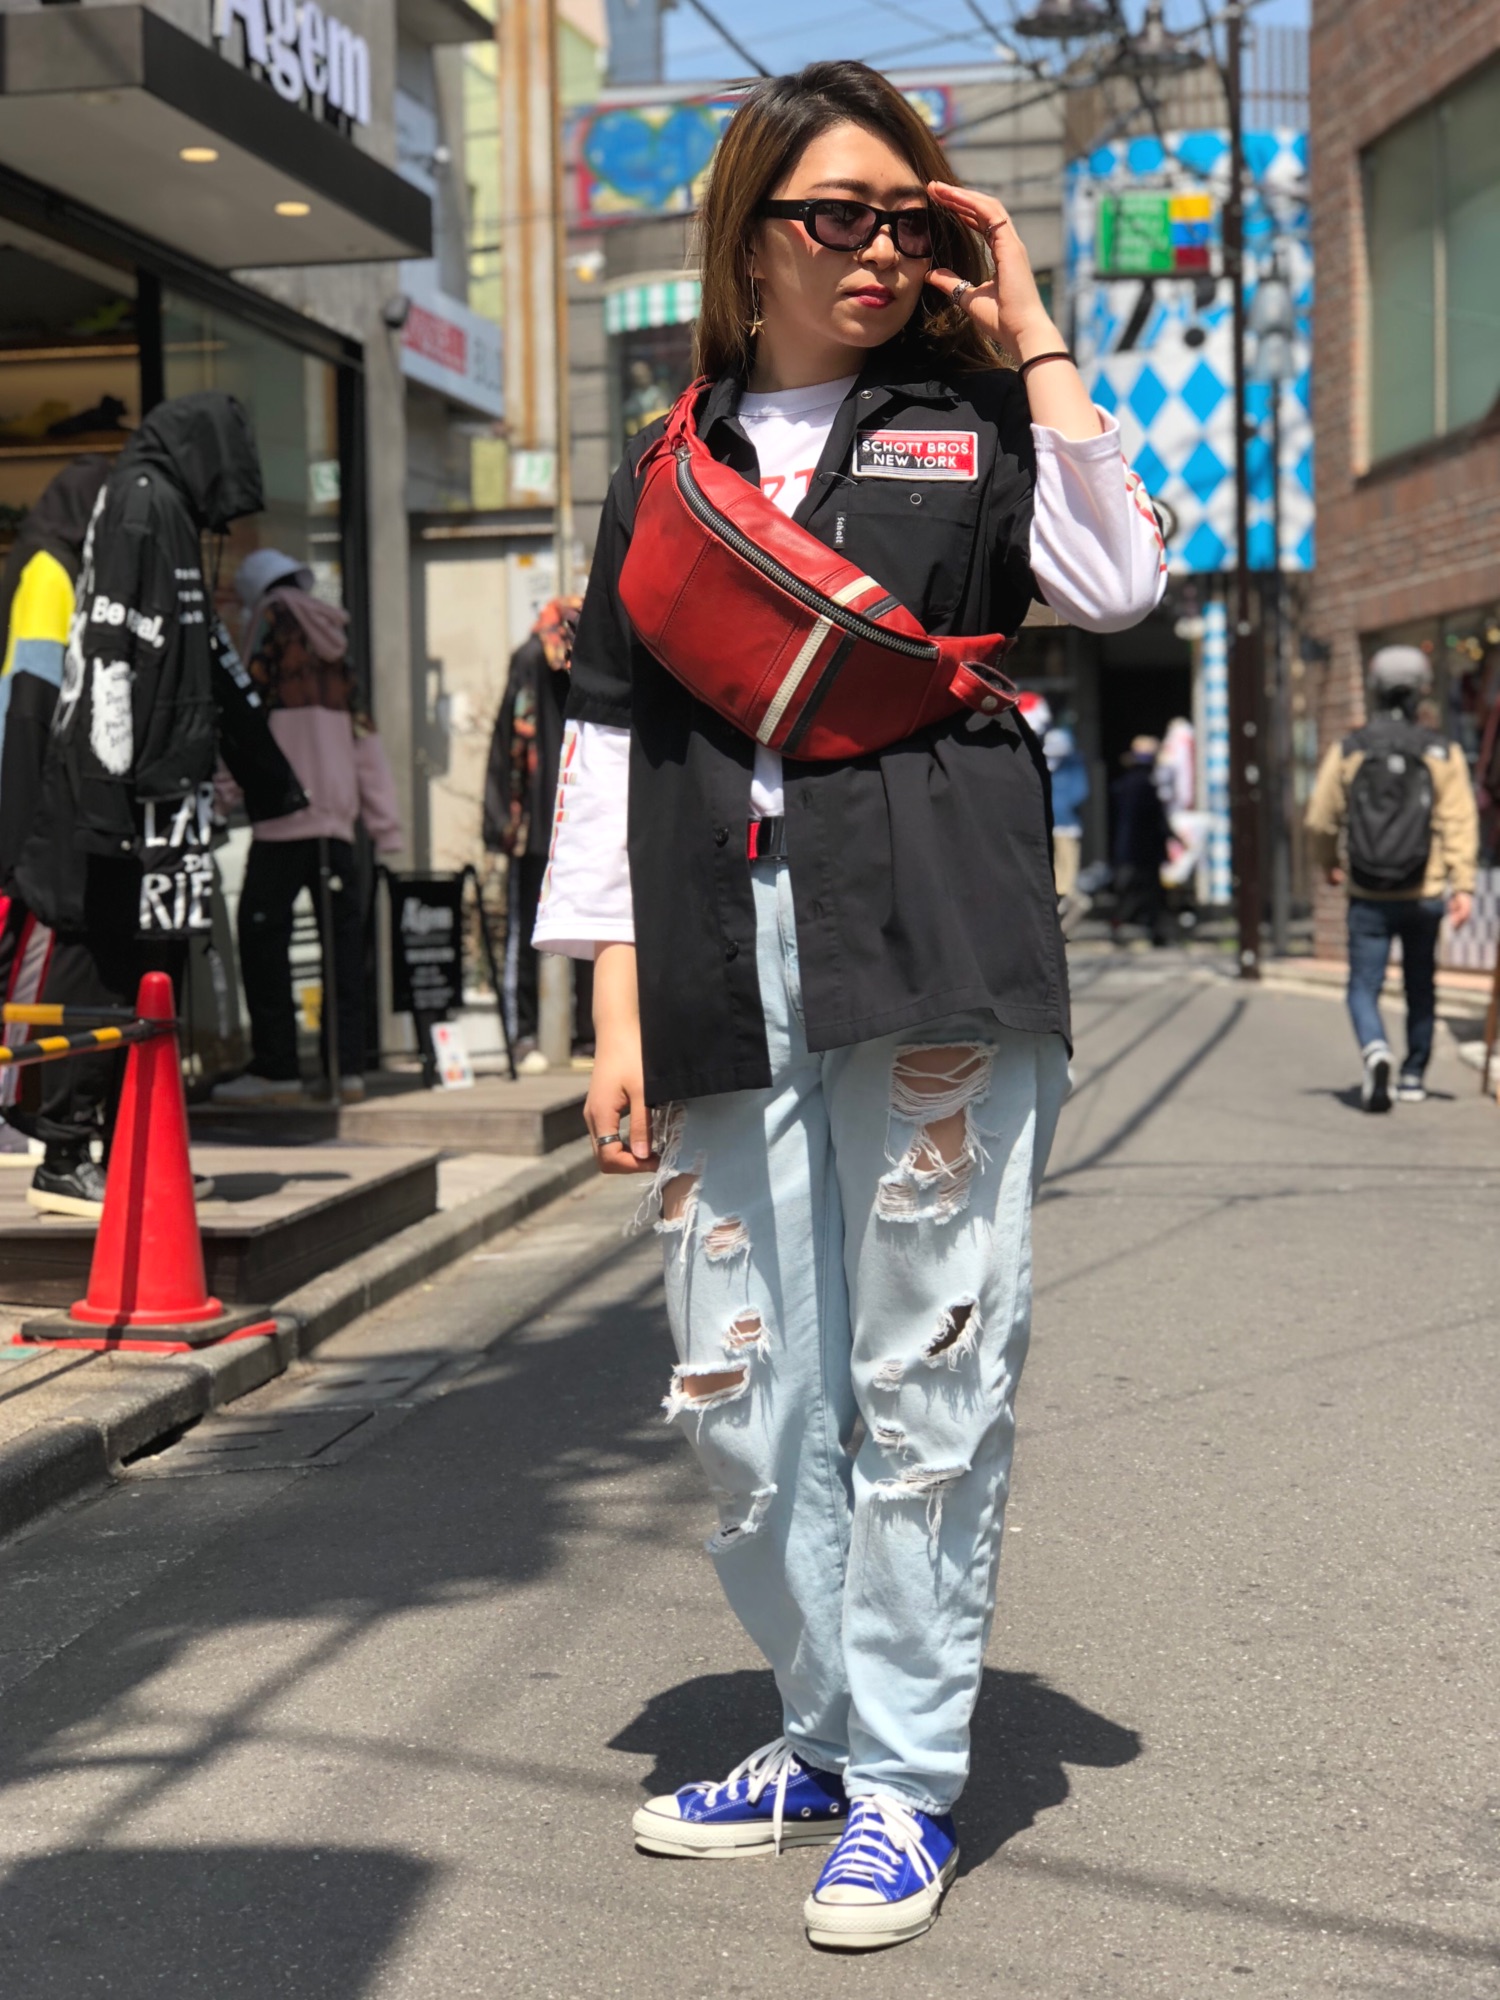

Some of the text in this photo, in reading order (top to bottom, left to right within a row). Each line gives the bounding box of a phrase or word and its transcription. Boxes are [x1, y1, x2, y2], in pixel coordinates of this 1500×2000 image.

[862, 440, 973, 455] SCHOTT BROS.
[873, 454, 957, 468] NEW YORK
[835, 516, 845, 543] Schott
[91, 595, 126, 626] Be
